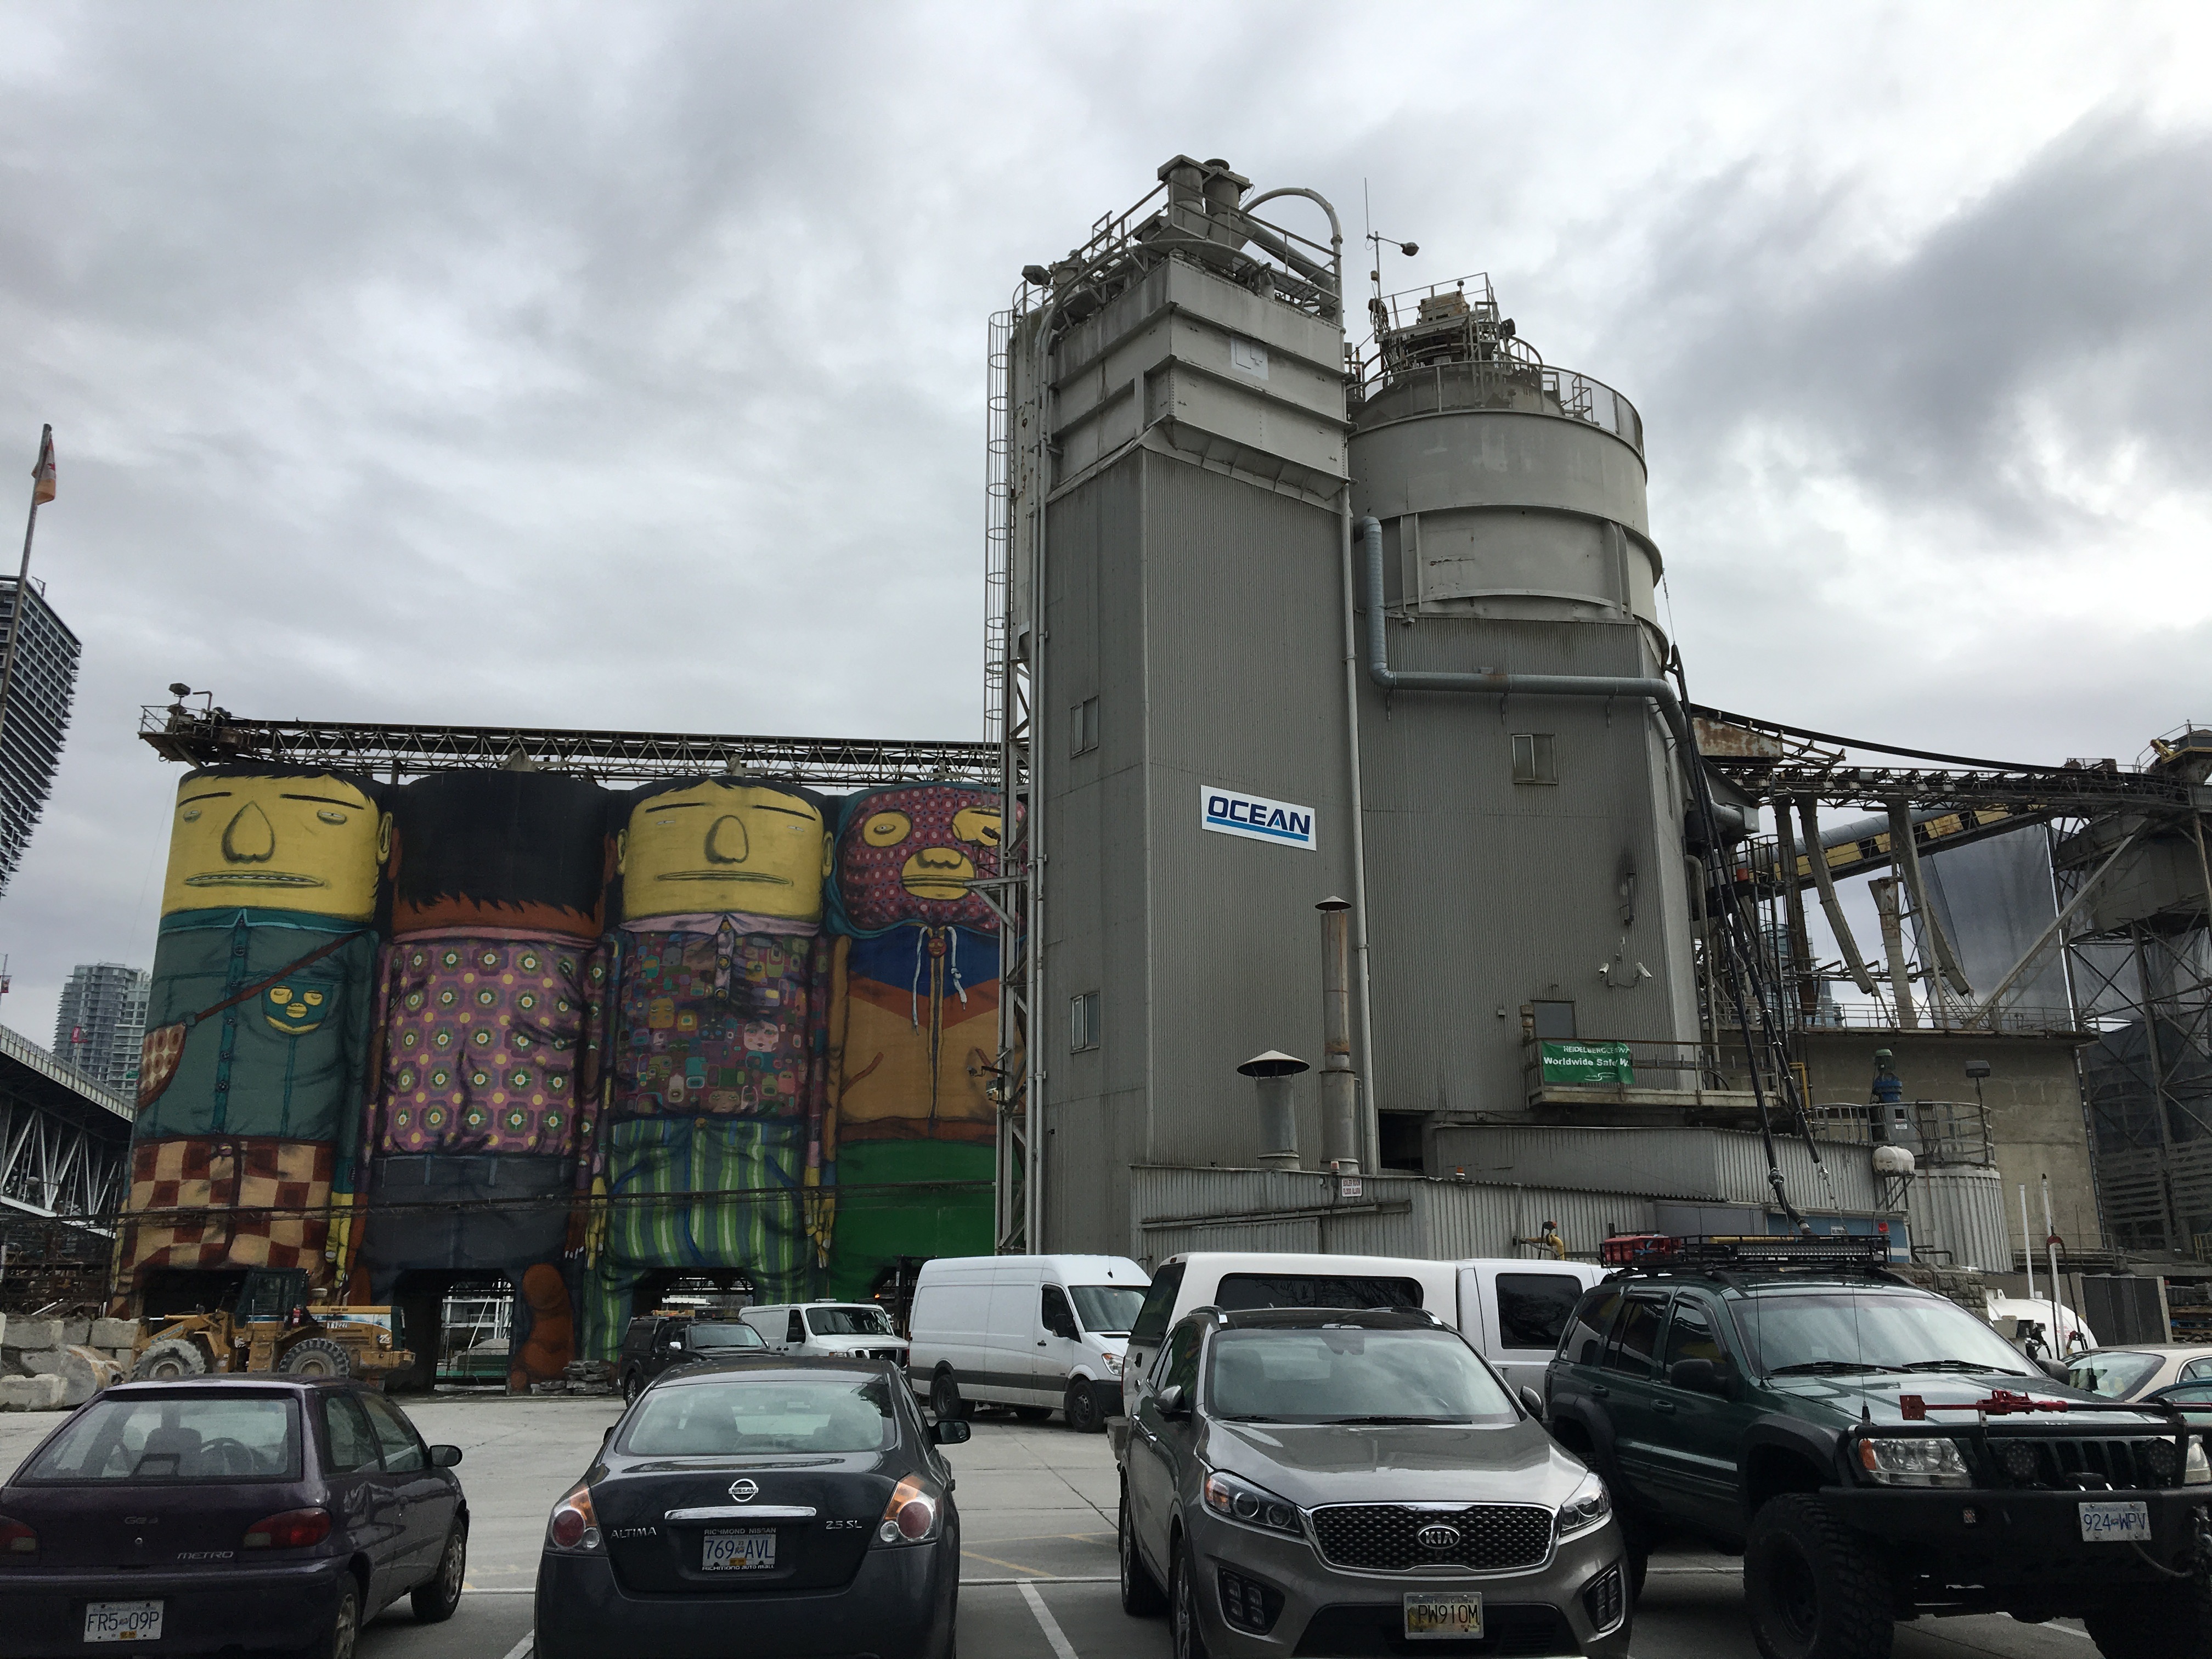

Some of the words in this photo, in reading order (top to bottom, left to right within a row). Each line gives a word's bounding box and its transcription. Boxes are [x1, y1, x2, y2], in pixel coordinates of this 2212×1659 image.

[1208, 795, 1310, 834] OCEAN
[1544, 1057, 1593, 1066] Worldwide
[847, 1520, 862, 1529] SL
[610, 1527, 657, 1538] ALTIMA
[1425, 1531, 1453, 1544] KIA
[177, 1551, 234, 1559] METRO
